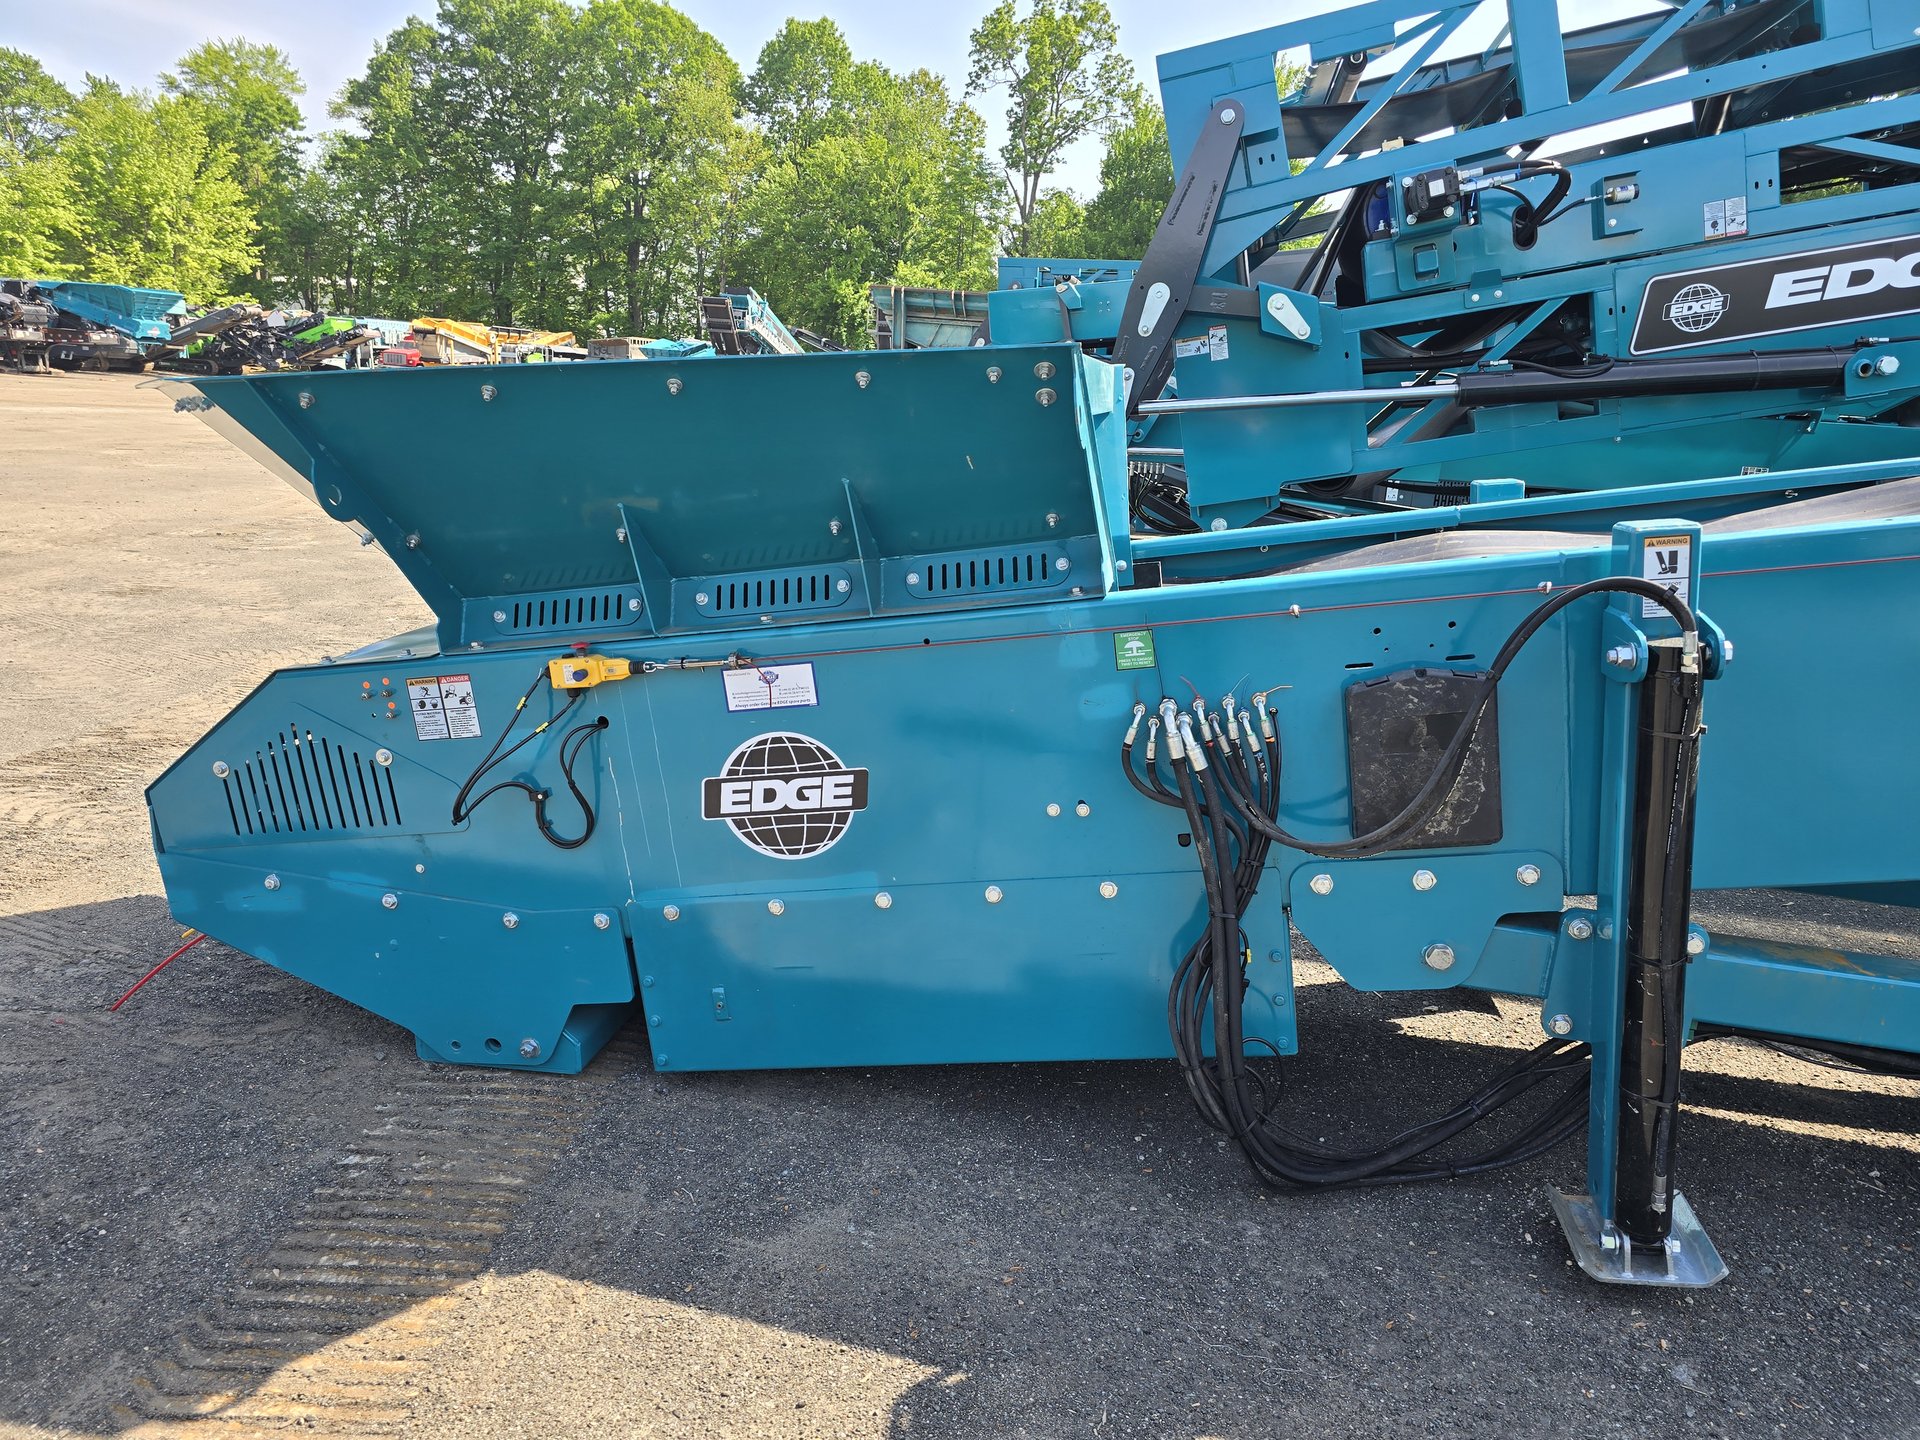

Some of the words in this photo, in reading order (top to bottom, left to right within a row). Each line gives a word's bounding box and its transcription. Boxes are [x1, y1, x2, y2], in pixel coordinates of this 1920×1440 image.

[1669, 296, 1724, 318] EDGE
[1656, 538, 1688, 546] WARNING
[720, 774, 855, 814] EDGE
